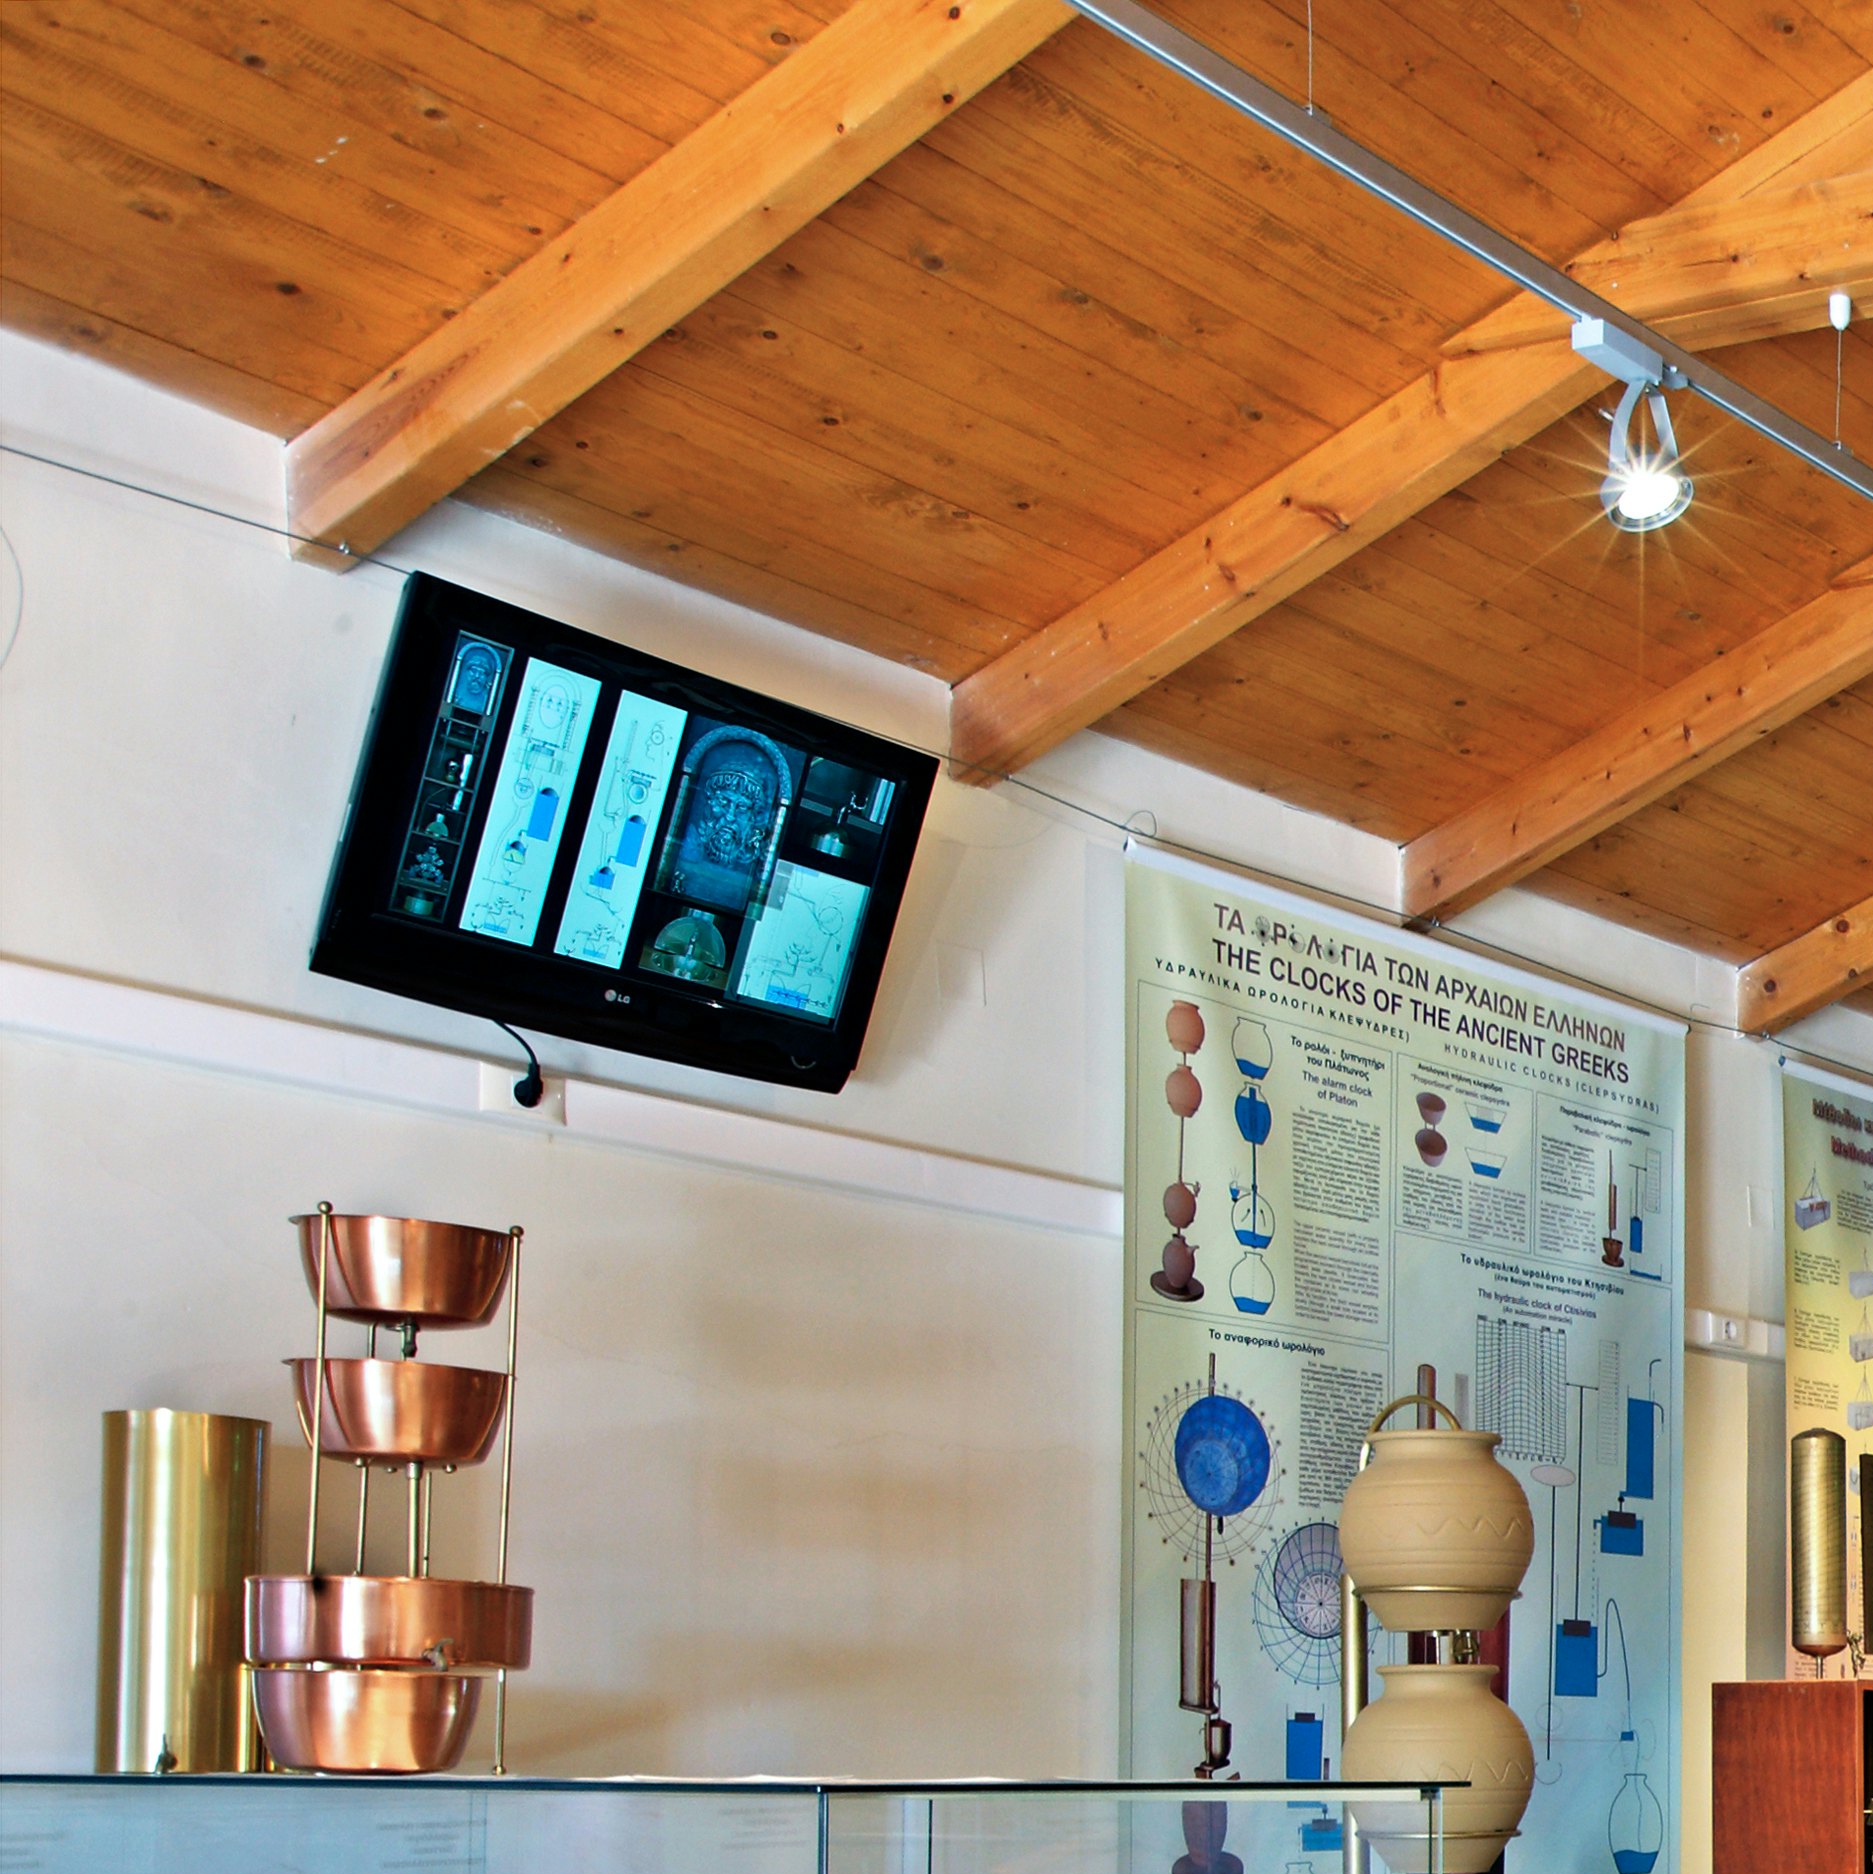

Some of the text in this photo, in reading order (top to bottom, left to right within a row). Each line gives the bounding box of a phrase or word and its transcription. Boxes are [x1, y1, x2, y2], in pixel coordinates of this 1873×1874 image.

[1155, 958, 1241, 993] ΥΔΡΑΥΛΙΚΑ
[1248, 986, 1325, 1017] ΩΡΟΛΟΓΙΑ
[1214, 903, 1245, 935] ΤΑ
[1385, 957, 1429, 992] ΤΩΝ
[1435, 975, 1527, 1022] ΑΡΧΑΙΩΝ
[1533, 1002, 1625, 1053] ΕΛΛΗΝΩΝ
[617, 993, 631, 1005] LG
[1212, 938, 1630, 1083] THE CLOCKS OF THE ANCIENT GREEKS
[1307, 1056, 1370, 1082] του Πλάτωνος
[1444, 1043, 1660, 1114] HYDRAULIC CLOCKS (CLEPSYDRAS)
[1303, 1070, 1373, 1098] The alarm clock
[1317, 1090, 1358, 1108] of Platon
[1478, 1288, 1492, 1300] The
[1494, 1291, 1529, 1307] hydraulic
[1531, 1299, 1552, 1311] clock
[1554, 1302, 1563, 1312] of
[1208, 1328, 1326, 1357] Το αναφορικό ωρολόγιο
